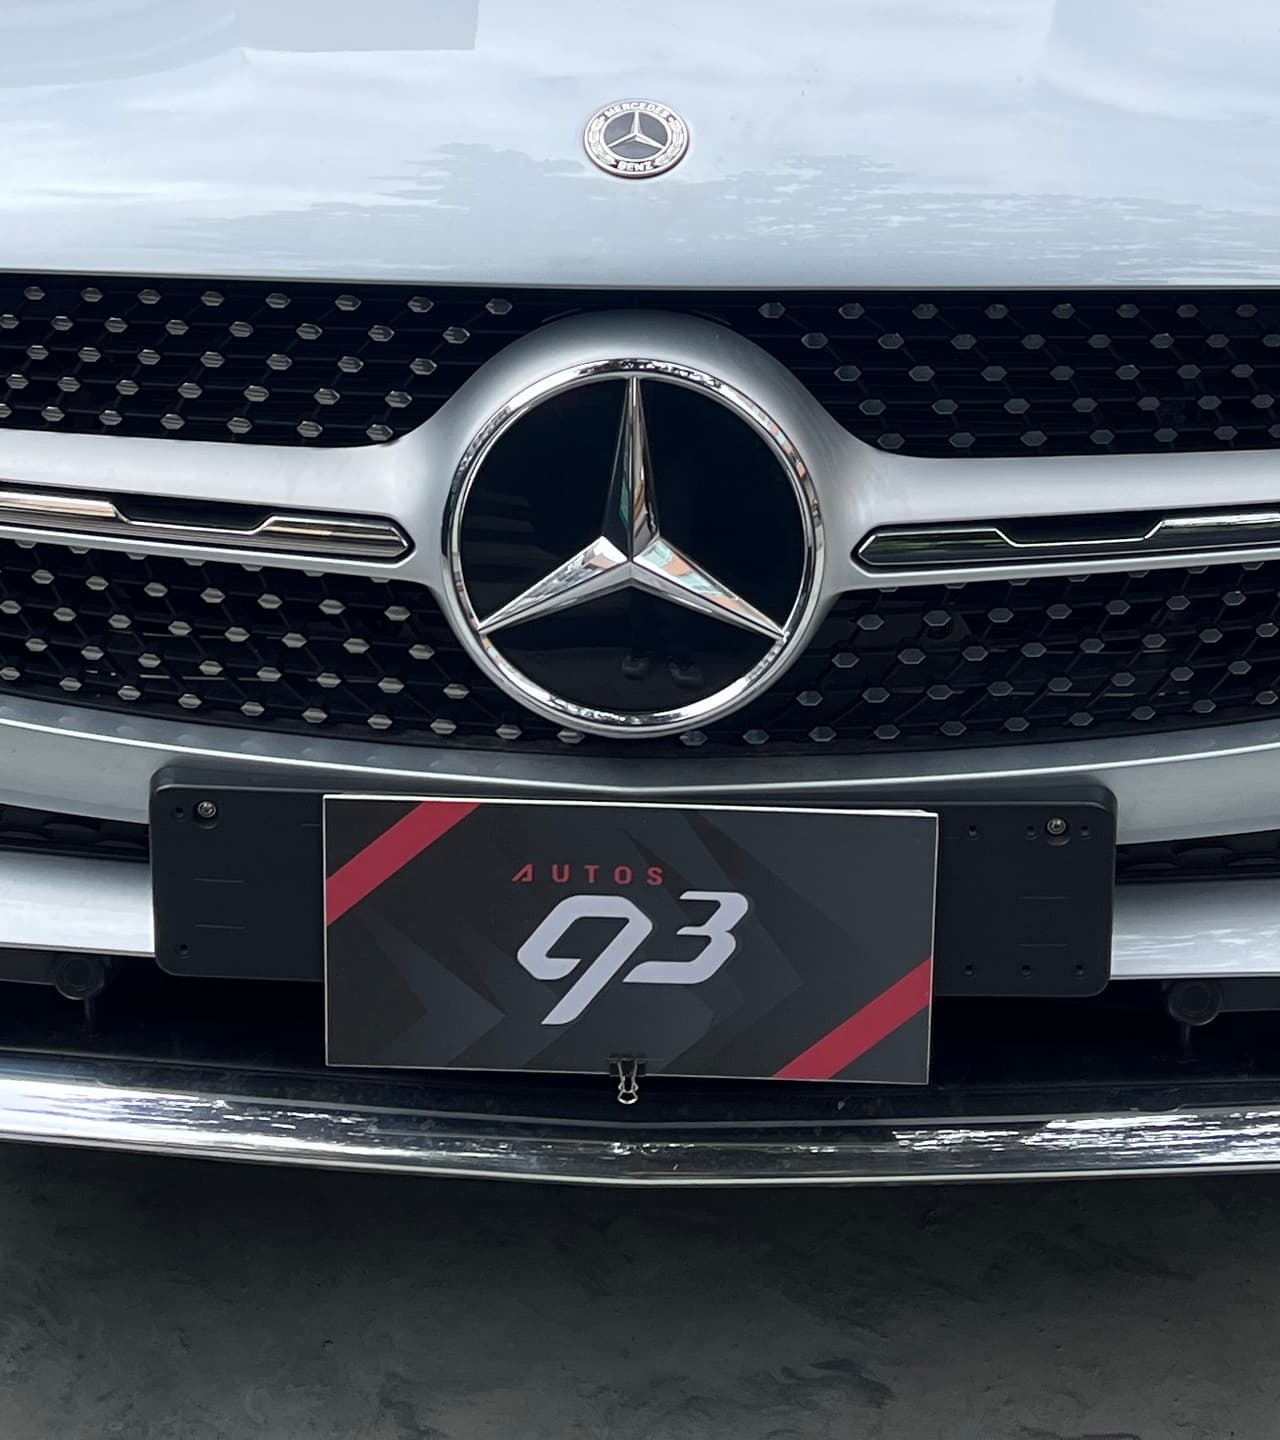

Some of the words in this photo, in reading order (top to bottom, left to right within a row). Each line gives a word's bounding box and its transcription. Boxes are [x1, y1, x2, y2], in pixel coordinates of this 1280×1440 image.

[604, 102, 670, 118] MERCEDES
[618, 160, 654, 172] BENZ
[512, 864, 664, 886] AUTOS
[517, 890, 749, 1025] 93
